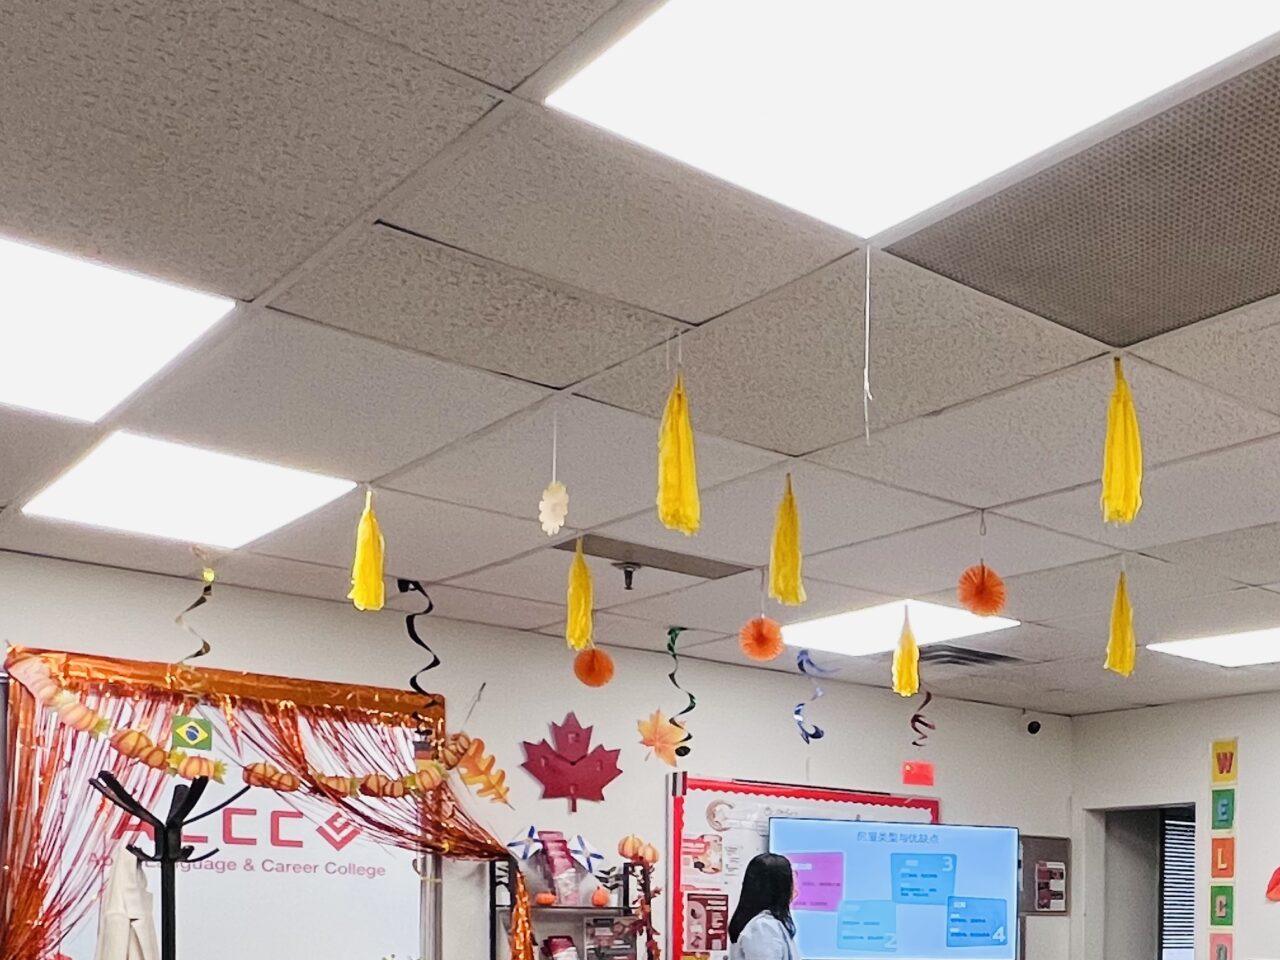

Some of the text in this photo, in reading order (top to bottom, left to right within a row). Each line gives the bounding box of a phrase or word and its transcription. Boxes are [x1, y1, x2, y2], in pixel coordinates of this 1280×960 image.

[243, 859, 255, 872] &
[261, 859, 319, 874] Career
[324, 861, 387, 880] College
[941, 856, 954, 872] 3
[991, 926, 1007, 943] 4
